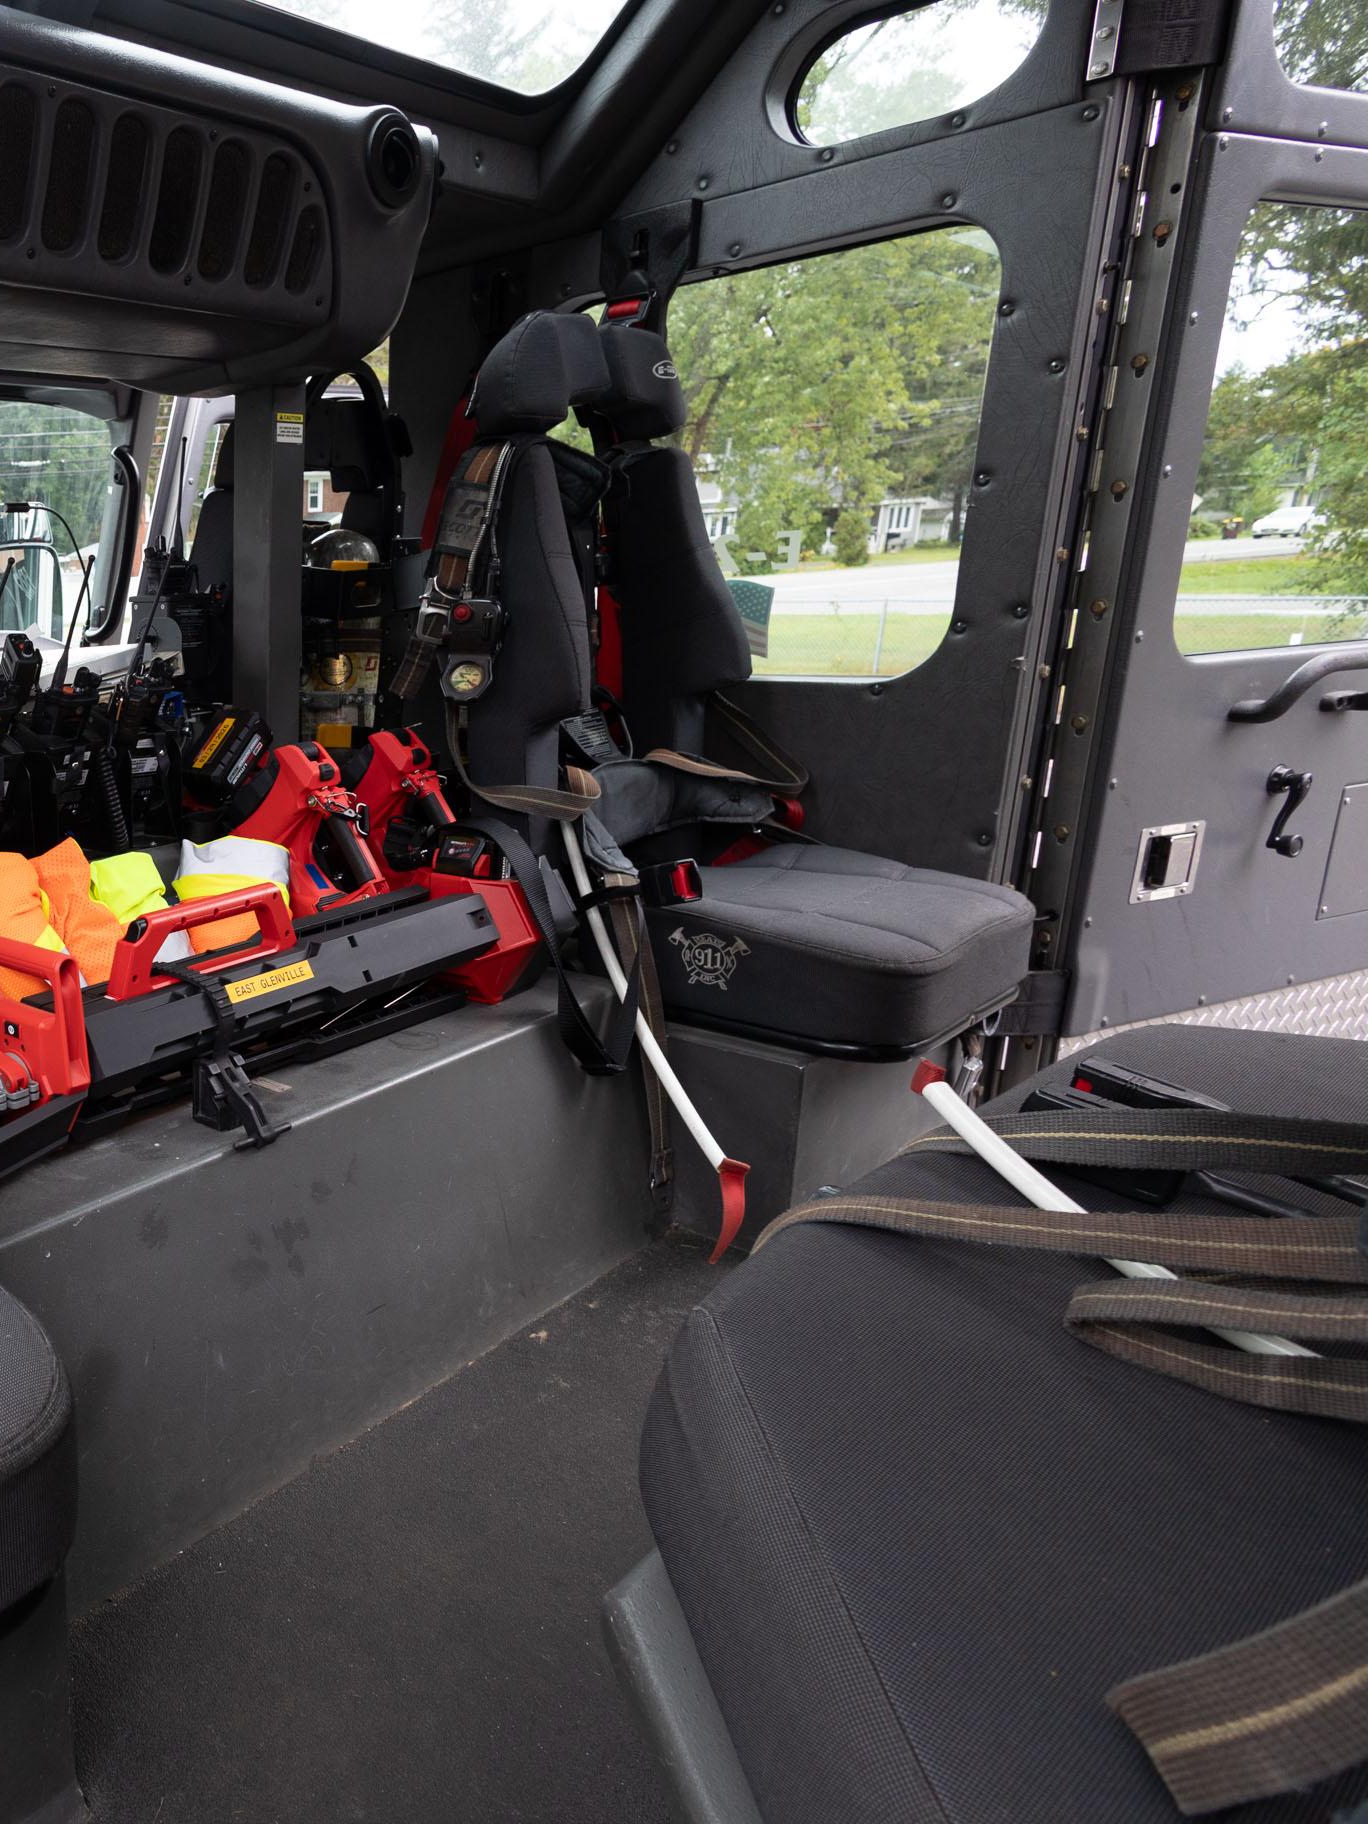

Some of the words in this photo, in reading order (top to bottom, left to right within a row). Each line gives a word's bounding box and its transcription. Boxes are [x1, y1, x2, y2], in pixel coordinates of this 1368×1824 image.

[694, 948, 722, 969] 911
[235, 982, 256, 997] EAST
[260, 967, 305, 989] GLENVILLE
